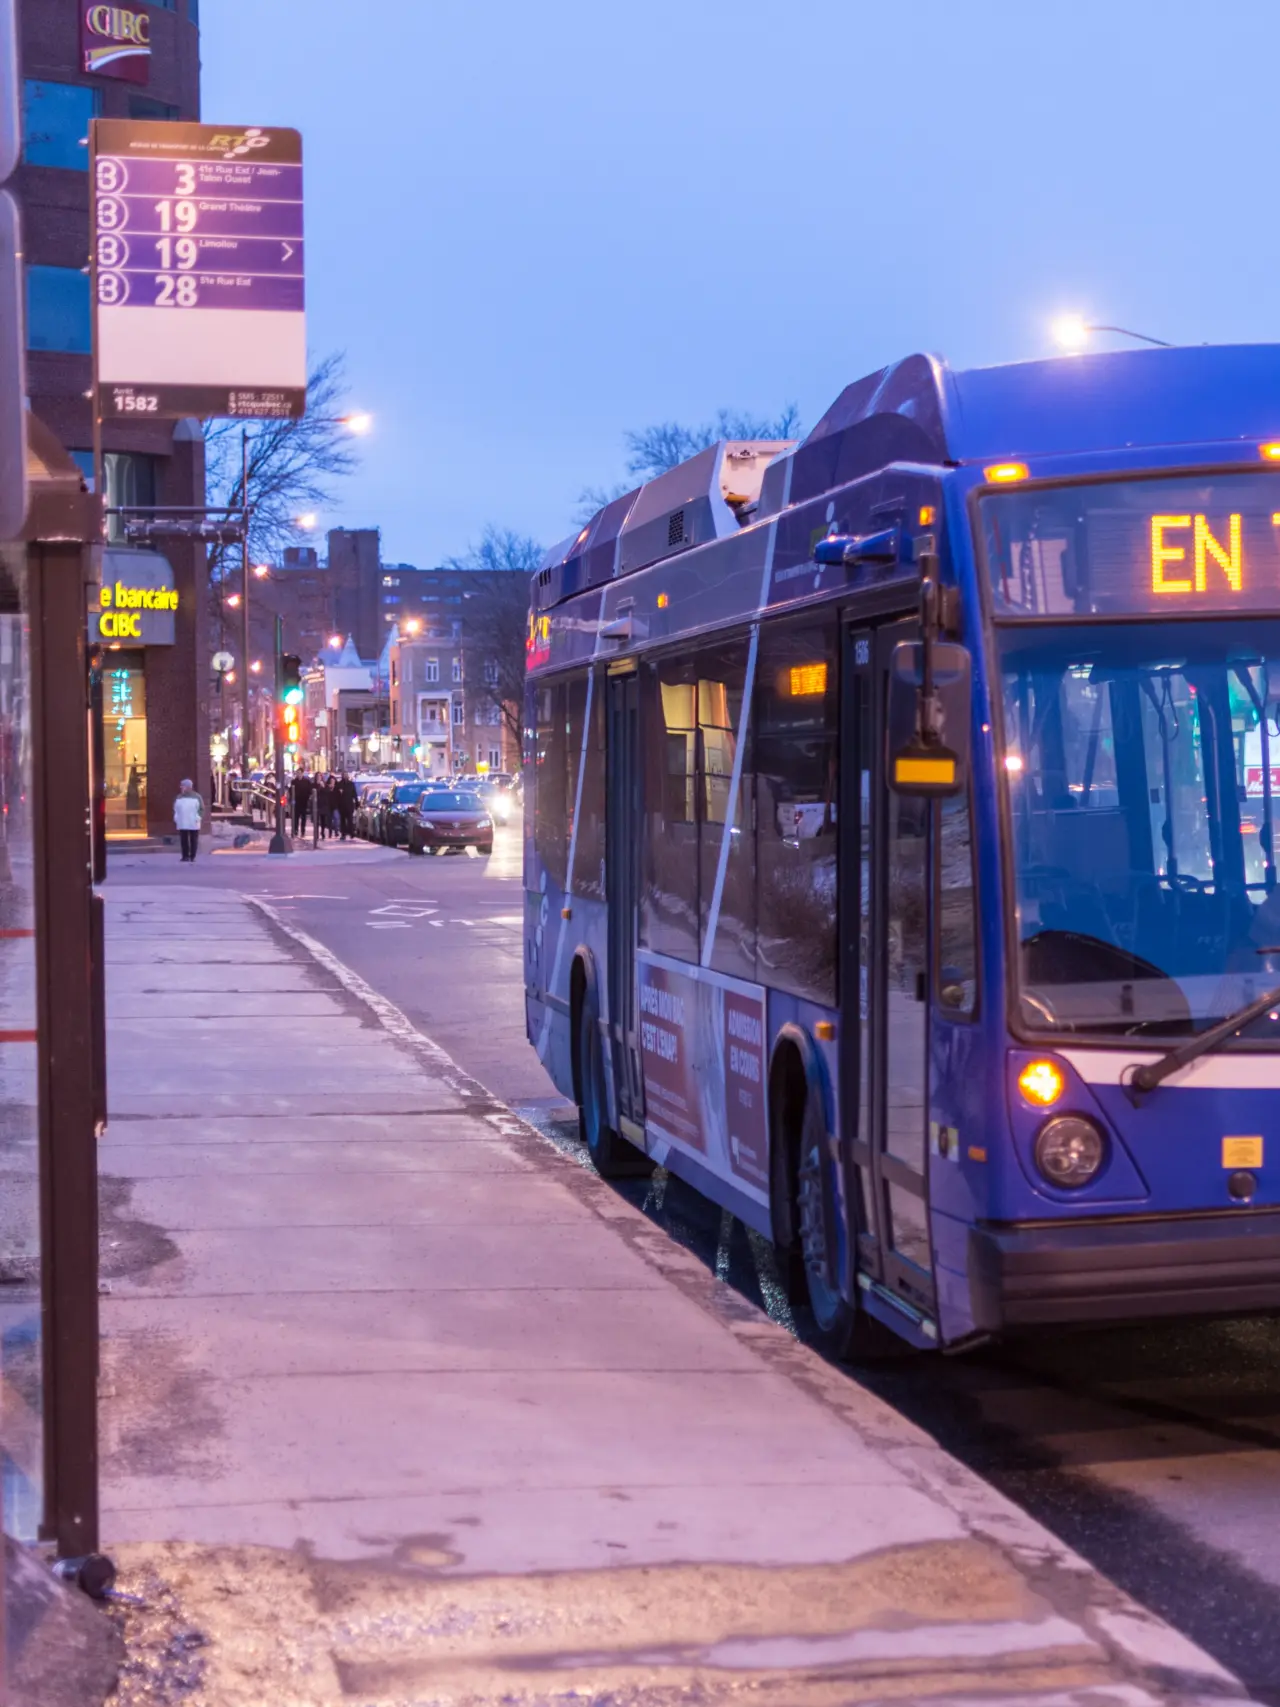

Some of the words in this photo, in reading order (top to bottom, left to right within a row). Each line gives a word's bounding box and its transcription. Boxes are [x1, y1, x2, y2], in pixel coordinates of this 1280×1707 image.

[87, 5, 150, 43] CIBC
[209, 134, 270, 148] RTC
[174, 163, 196, 196] 3
[215, 166, 232, 174] Rue
[155, 200, 197, 233] 19
[200, 201, 226, 211] Grand
[155, 238, 198, 270] 19
[154, 275, 198, 307] 28
[216, 277, 234, 285] Rue
[114, 396, 158, 411] 1582
[1151, 513, 1242, 593] EN
[115, 580, 179, 611] bancaire
[99, 612, 142, 637] CIBC
